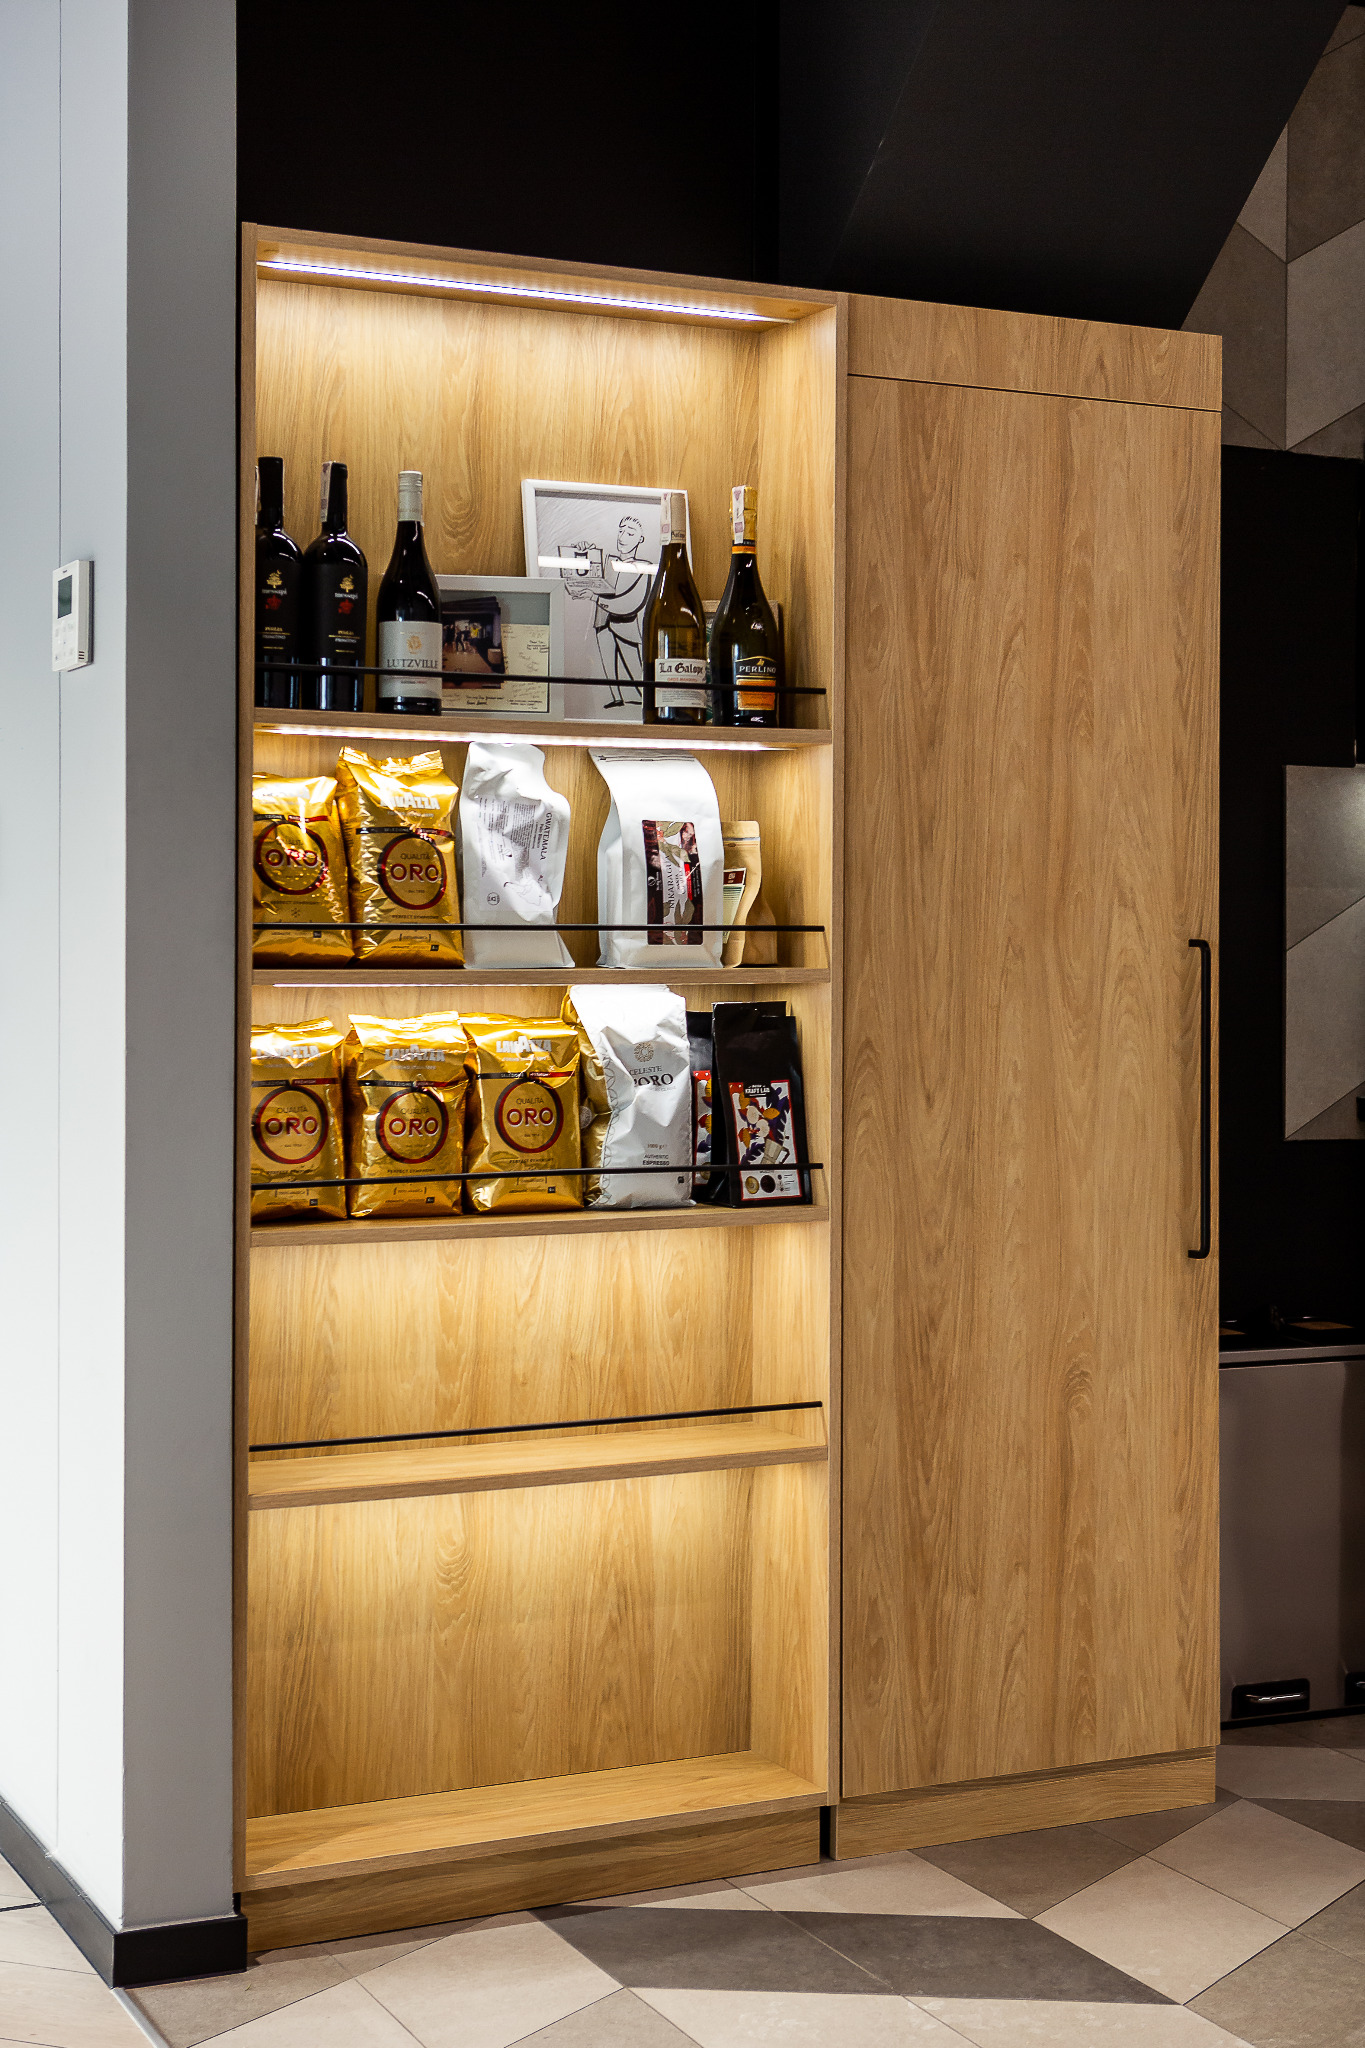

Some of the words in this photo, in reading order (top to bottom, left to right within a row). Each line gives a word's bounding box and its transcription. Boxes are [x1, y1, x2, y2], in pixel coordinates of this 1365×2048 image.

[386, 658, 438, 669] LUTZVILLE
[659, 662, 673, 674] La
[739, 665, 777, 673] PERLINO
[540, 812, 553, 861] GWATEMALA
[265, 848, 320, 869] ORO
[390, 863, 441, 883] ORO
[384, 1044, 445, 1062] LAVAZZA
[264, 1116, 319, 1136] ORO
[388, 1117, 440, 1137] ORO
[506, 1107, 555, 1127] ORO
